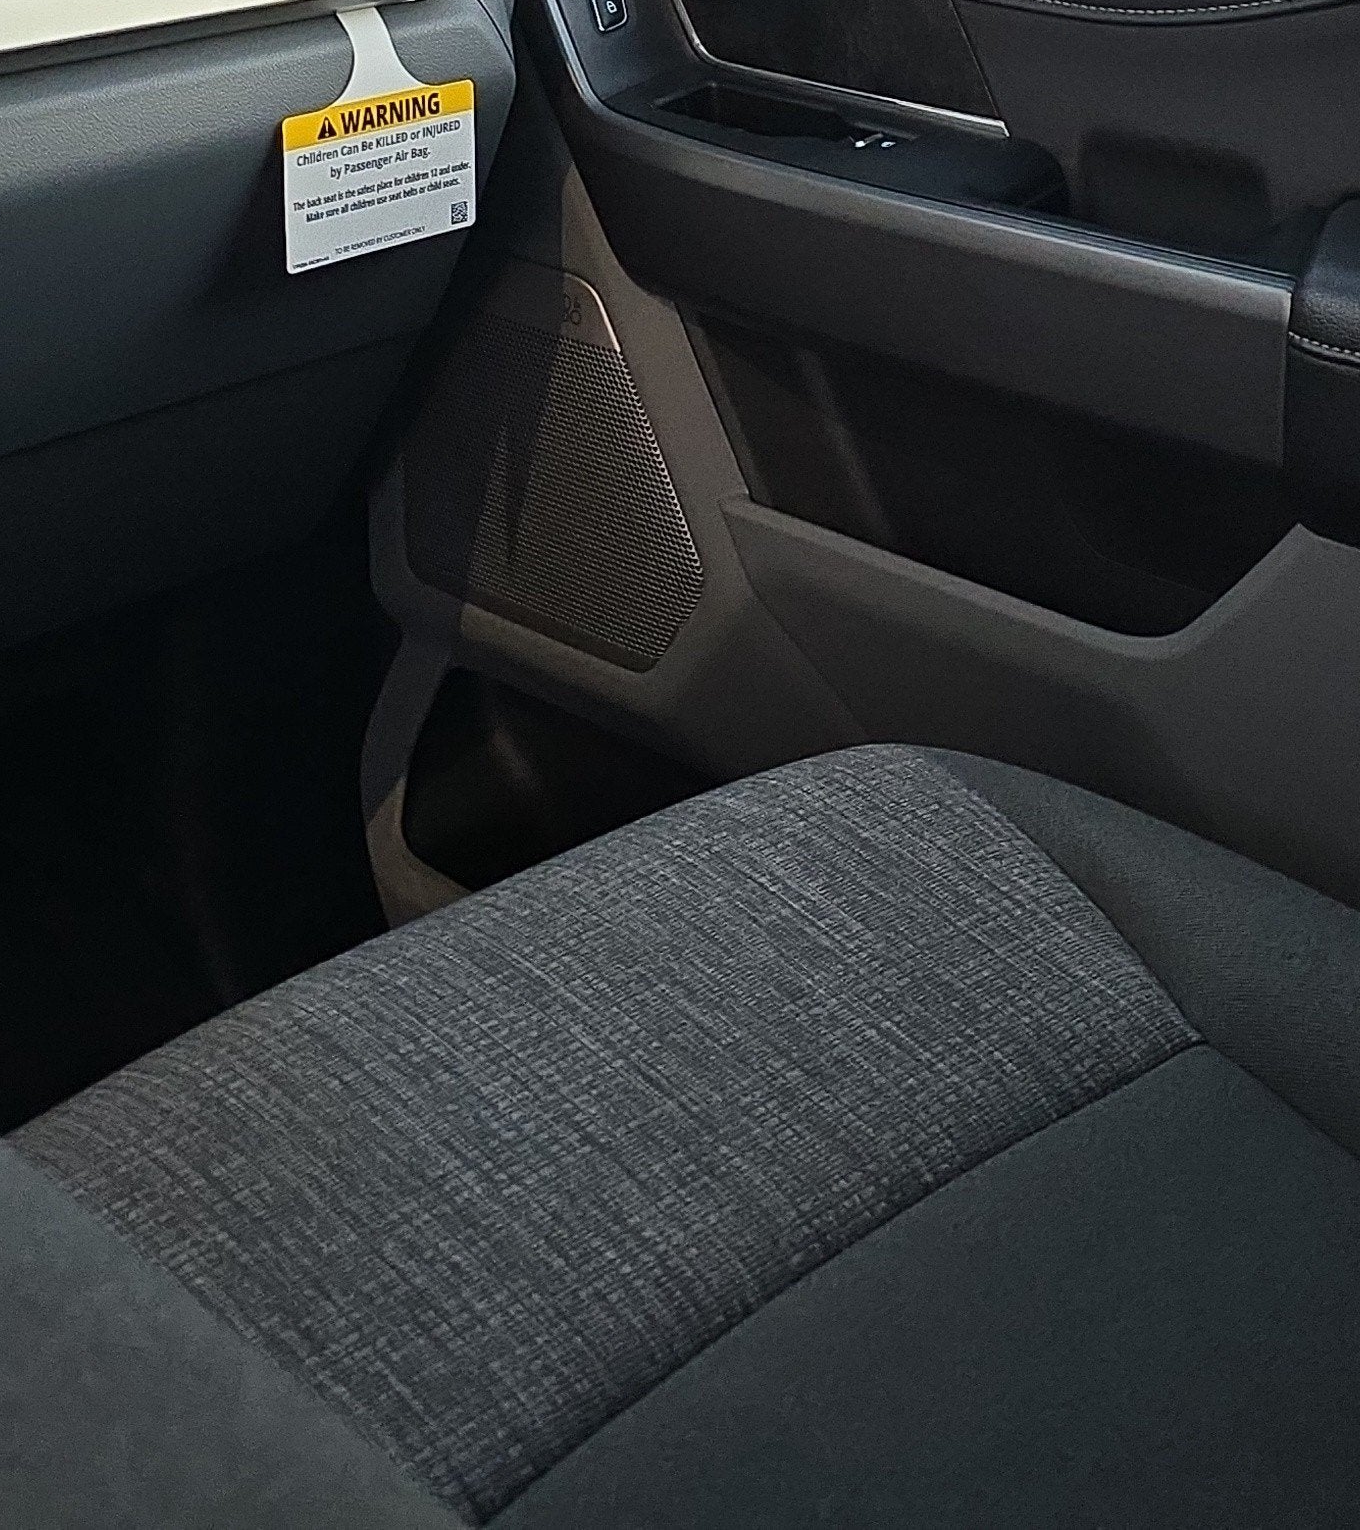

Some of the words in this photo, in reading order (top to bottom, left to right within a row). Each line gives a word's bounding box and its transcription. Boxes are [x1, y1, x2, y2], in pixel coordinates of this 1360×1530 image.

[340, 92, 440, 135] WARNING
[296, 150, 339, 166] Children
[340, 144, 359, 156] Can
[361, 140, 374, 151] Be
[375, 131, 408, 148] KILLED
[410, 130, 421, 140] or
[422, 120, 461, 138] INJURED
[330, 166, 342, 180] by
[344, 155, 393, 174] Passenger
[395, 149, 409, 162] Air
[411, 147, 431, 159] Bag.
[293, 201, 306, 211] The
[306, 196, 322, 208] back
[323, 193, 338, 204] seat
[345, 188, 356, 198] the
[357, 184, 376, 196] safest
[376, 181, 393, 193] place
[394, 177, 403, 187] for
[404, 172, 429, 184] children
[431, 168, 438, 177] 12
[439, 164, 450, 175] and
[306, 211, 324, 223] Make
[325, 207, 340, 217] sure
[341, 203, 349, 213] all
[350, 199, 376, 211] children
[376, 196, 388, 205] use
[388, 191, 402, 202] seat
[403, 187, 418, 198] belts
[427, 180, 442, 192] child
